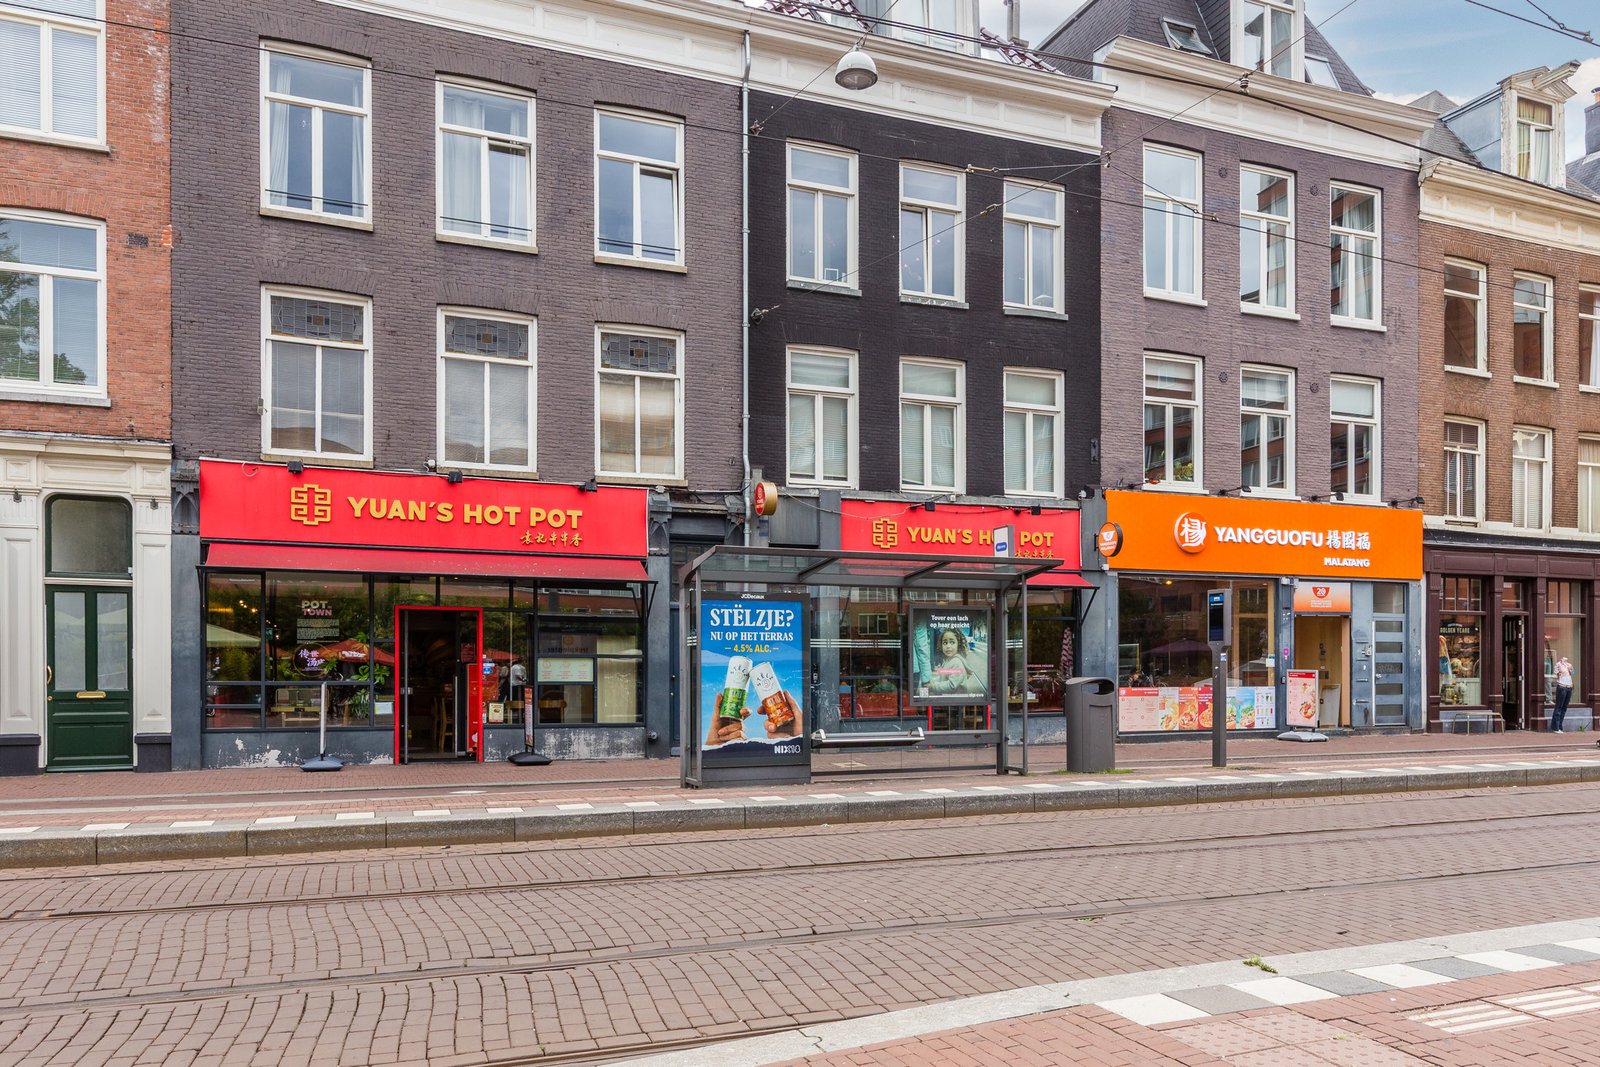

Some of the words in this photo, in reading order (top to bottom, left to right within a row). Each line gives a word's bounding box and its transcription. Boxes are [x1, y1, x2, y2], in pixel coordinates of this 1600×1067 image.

[347, 496, 454, 522] YUAN'S
[463, 503, 521, 526] HOT
[529, 507, 583, 529] POT
[907, 526, 973, 544] YUAN'S
[1020, 531, 1054, 547] POT
[1214, 526, 1323, 547] YANGGUOFU
[1324, 557, 1370, 567] MALATANG
[301, 600, 328, 609] POT
[710, 603, 795, 631] STËLZJE?
[710, 631, 723, 641] NU
[725, 631, 738, 641] OP
[740, 632, 760, 641] HET
[760, 632, 794, 641] TERRAS
[733, 644, 753, 653] 4.5%
[754, 644, 772, 653] ALC.
